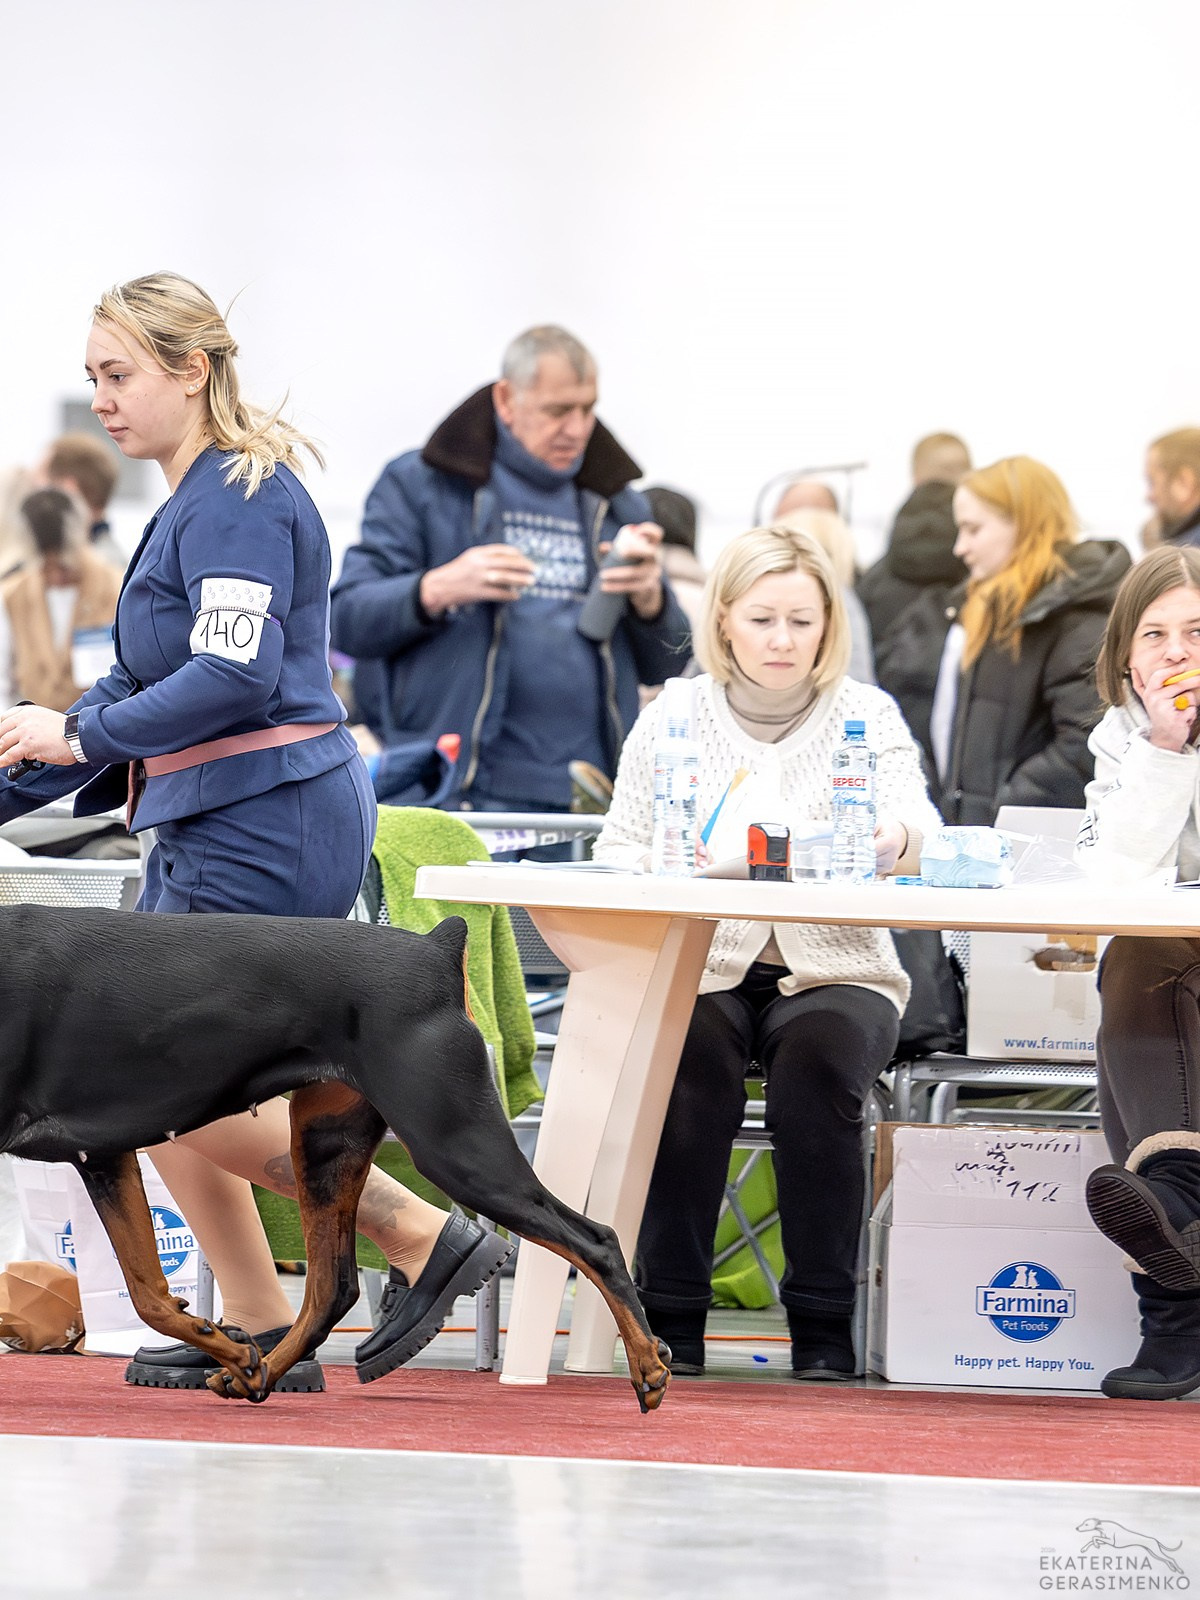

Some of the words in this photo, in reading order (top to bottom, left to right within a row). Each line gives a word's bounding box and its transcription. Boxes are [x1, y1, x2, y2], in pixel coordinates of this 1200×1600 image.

[200, 609, 254, 649] 140
[1004, 1036, 1095, 1051] www.farmina
[983, 1290, 1069, 1314] Farmina
[1002, 1320, 1018, 1331] Pet
[1021, 1320, 1049, 1332] Foods
[954, 1354, 993, 1370] Happy
[997, 1356, 1021, 1370] pet.
[1025, 1356, 1065, 1372] Happy
[1067, 1358, 1095, 1371] You.
